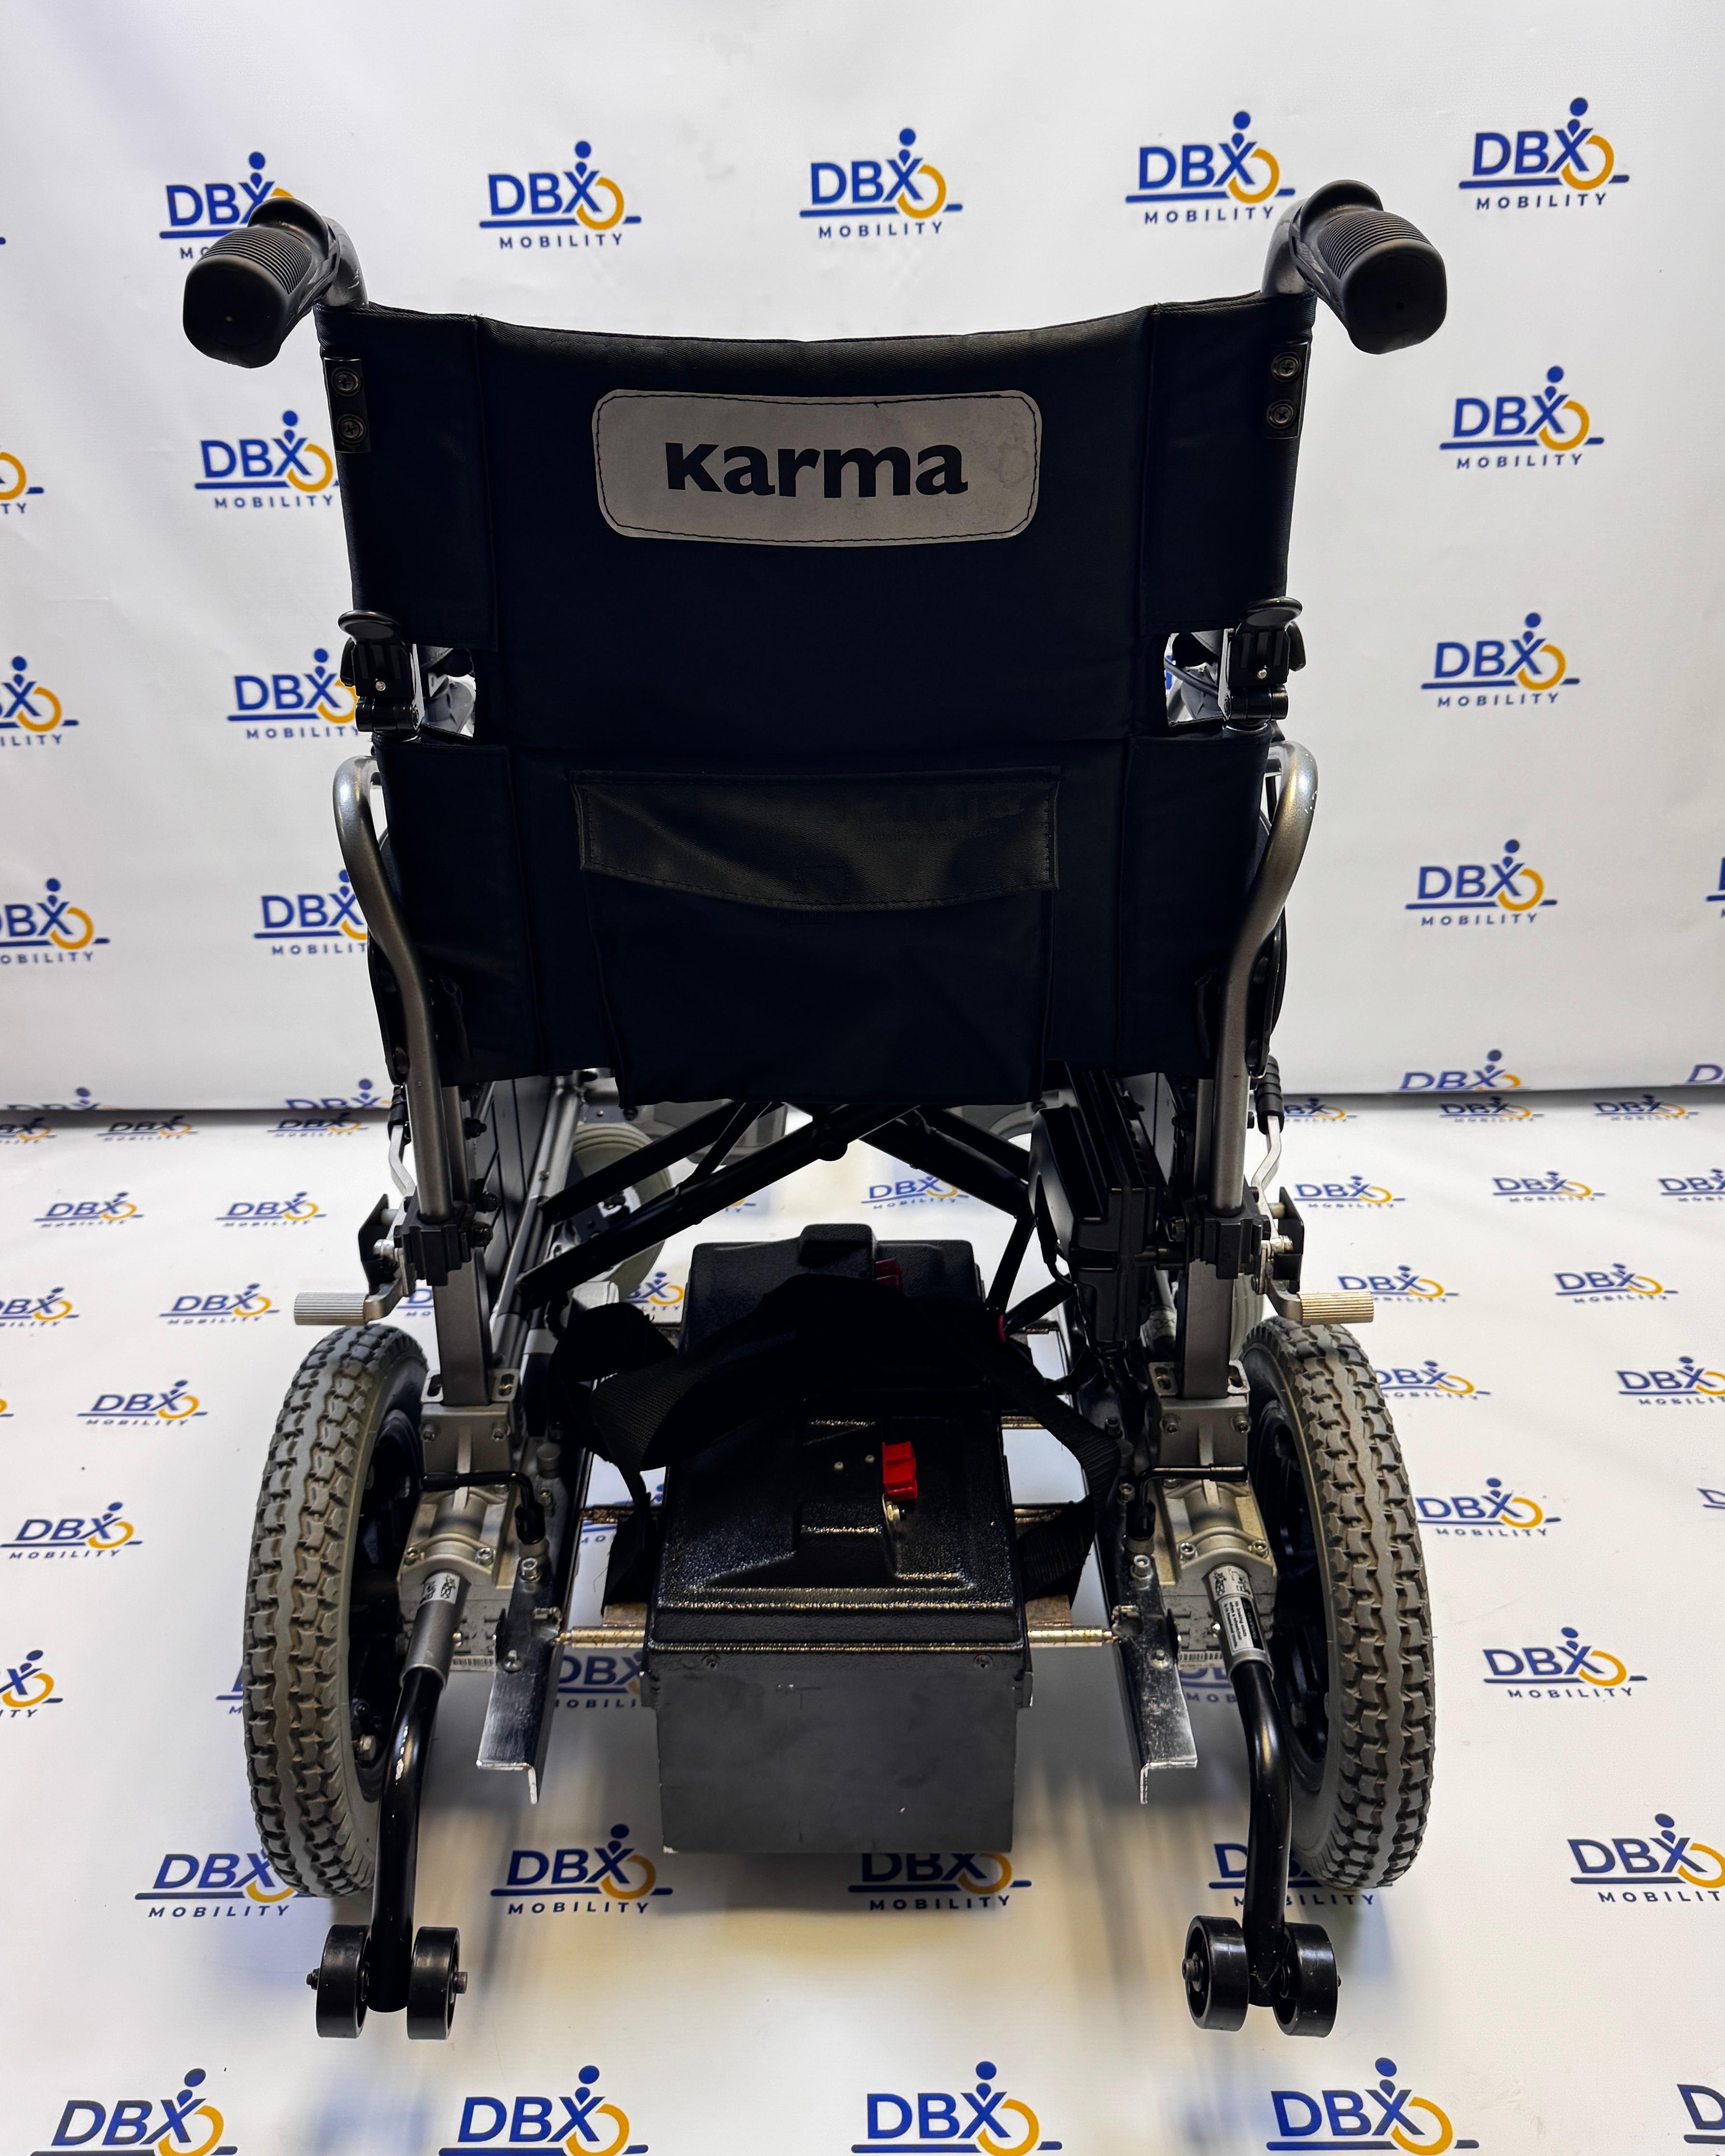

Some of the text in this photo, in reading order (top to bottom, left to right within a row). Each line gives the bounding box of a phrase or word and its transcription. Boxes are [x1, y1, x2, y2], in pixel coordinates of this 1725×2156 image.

[1476, 193, 1606, 210] MOBILITY
[1145, 206, 1273, 224] MOBILITY
[819, 222, 942, 238] MOBILITY
[500, 233, 622, 249] MOBILITY
[1457, 454, 1582, 469] MOBILITY
[214, 495, 332, 508] MOBILITY
[1438, 693, 1558, 707] MOBILITY
[246, 723, 362, 739] MOBILITY
[0, 902, 74, 939] BX
[1421, 913, 1537, 926] MOBILITY
[272, 943, 365, 955] MOBILIT
[0, 952, 93, 965] OBILITY
[0, 1297, 61, 1314] BX
[1436, 1526, 1546, 1537] MOBILITY
[10, 1549, 121, 1560] MOBILITY
[1507, 1687, 1631, 1698] MOBILITY
[870, 1894, 1011, 1912] MOBILITY
[1598, 1890, 1720, 1903] MOBILIT
[148, 1905, 290, 1918] MOBILITY
[507, 1901, 650, 1916] MOBILITY
